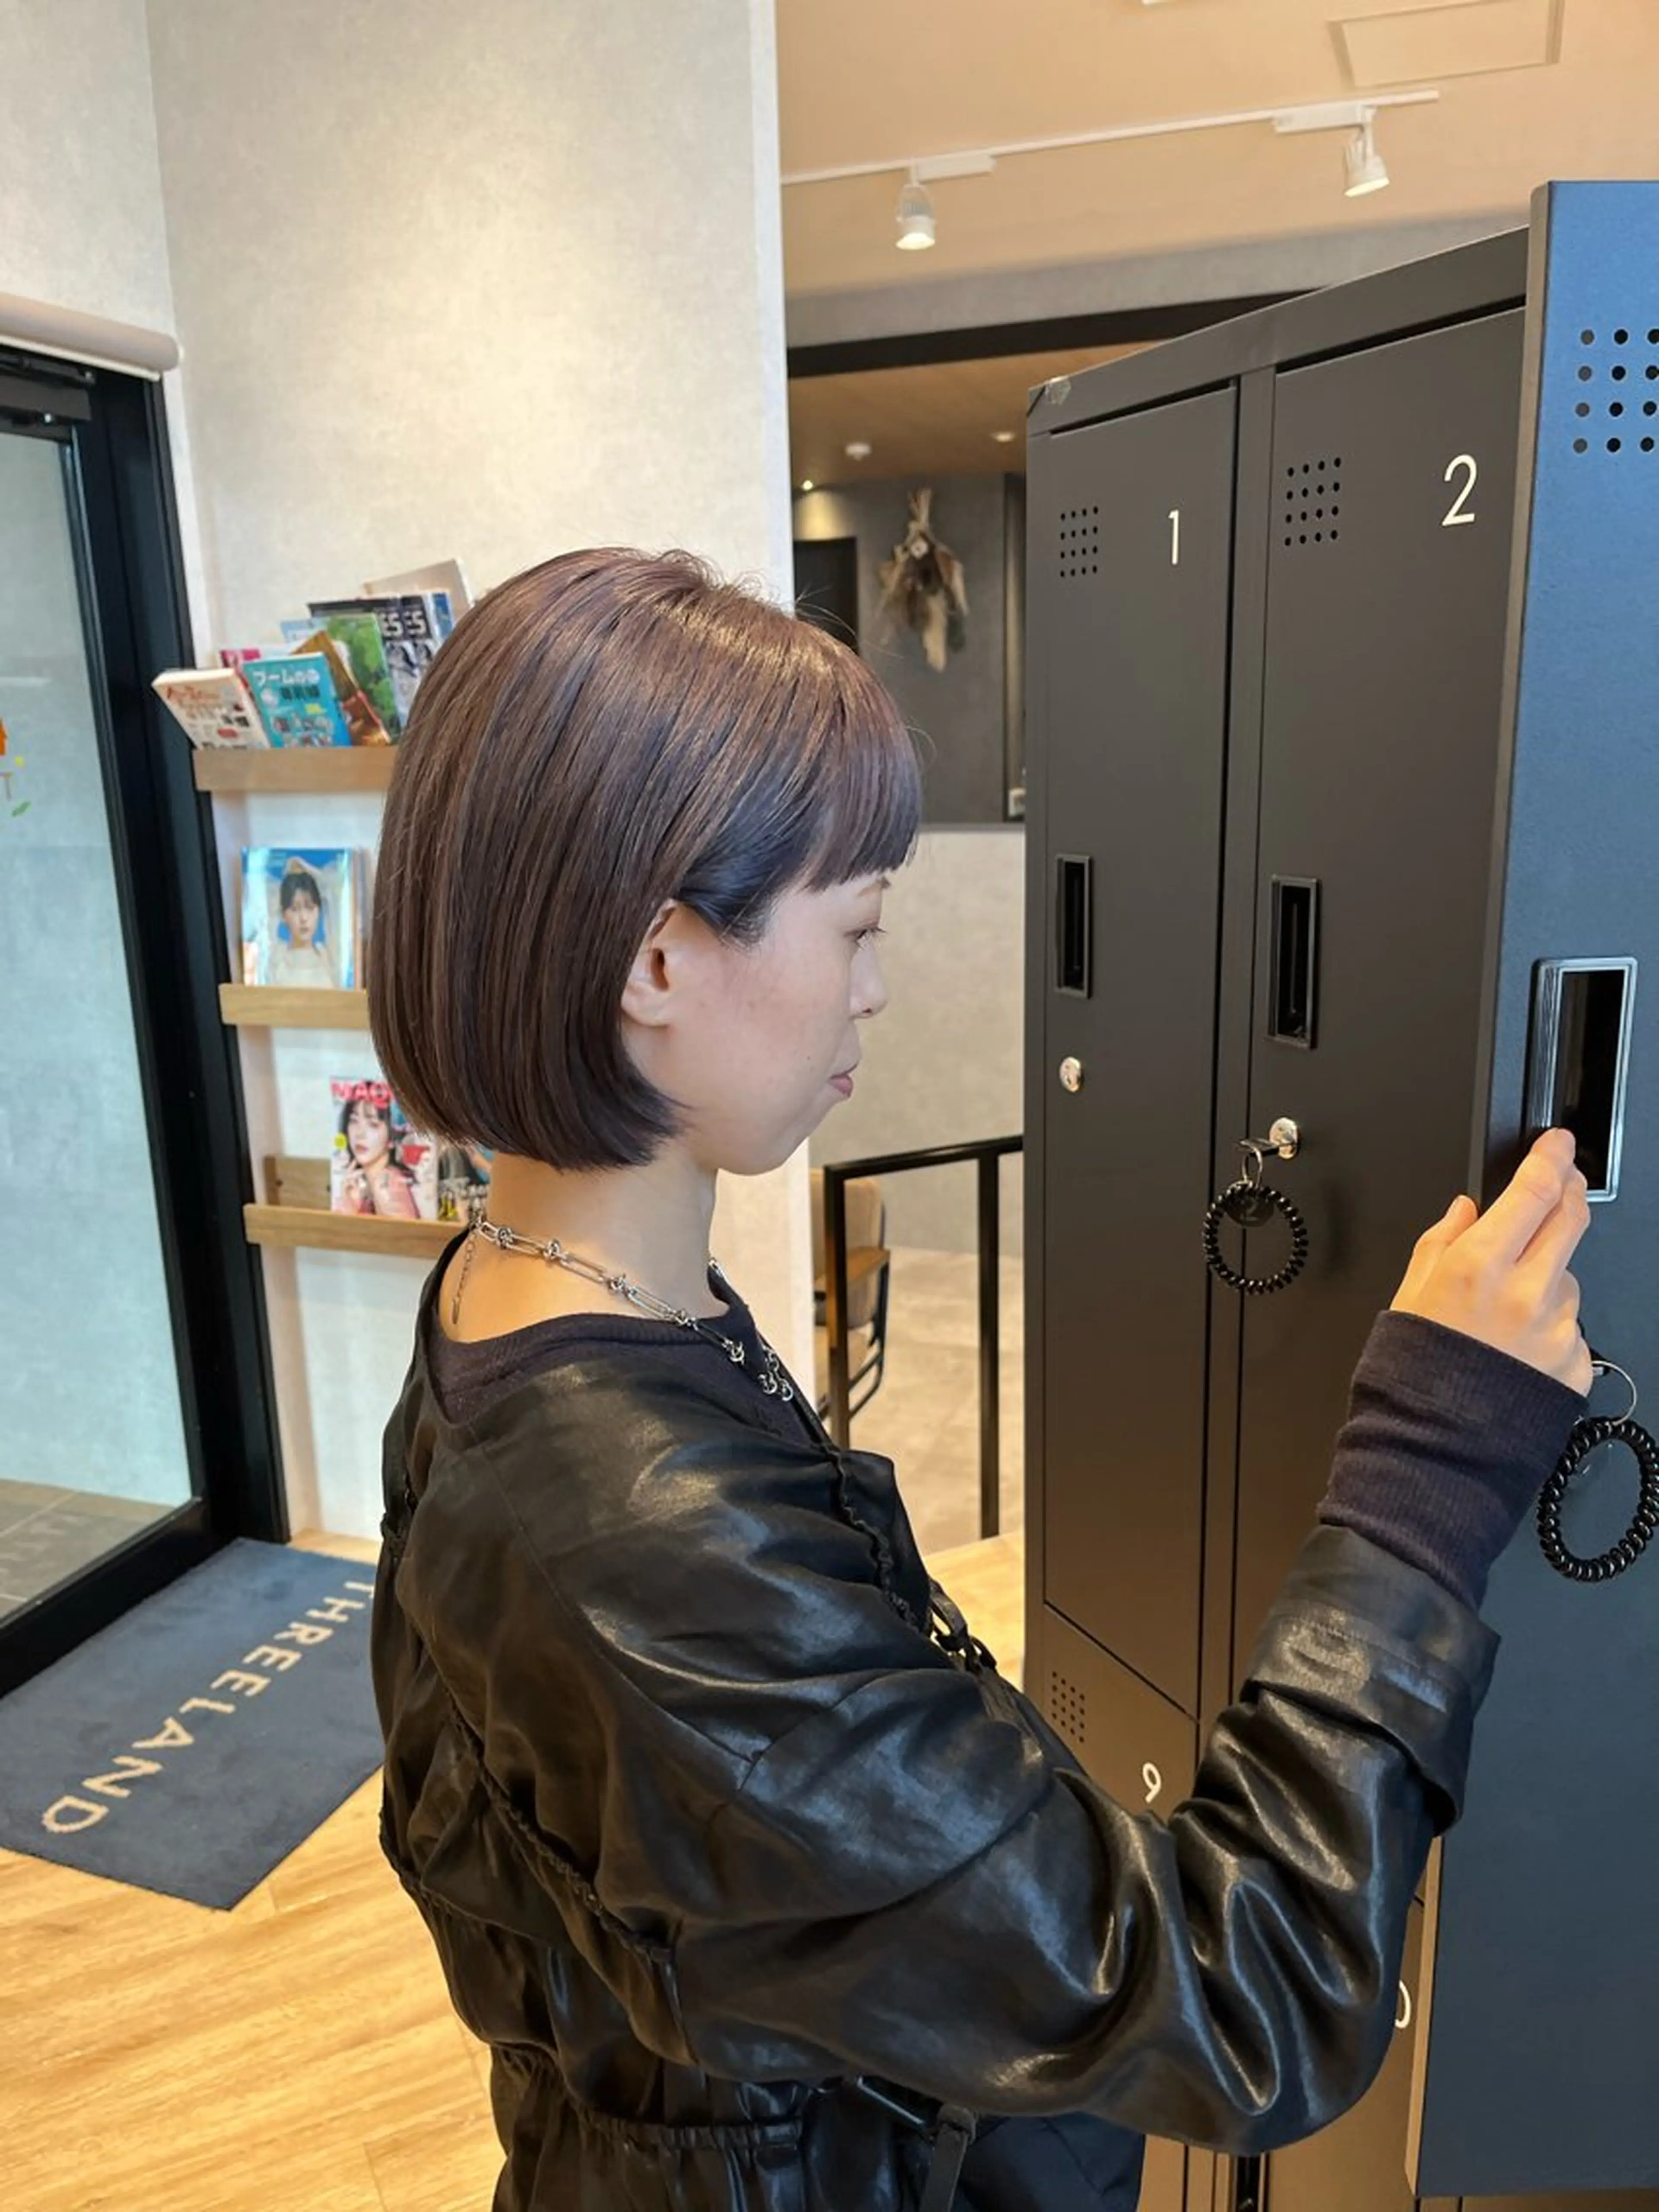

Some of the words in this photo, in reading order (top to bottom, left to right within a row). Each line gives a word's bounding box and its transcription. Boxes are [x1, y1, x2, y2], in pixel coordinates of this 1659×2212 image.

[1441, 454, 1477, 526] 2
[1168, 509, 1179, 565] 1
[1142, 1762, 1161, 1804] 9
